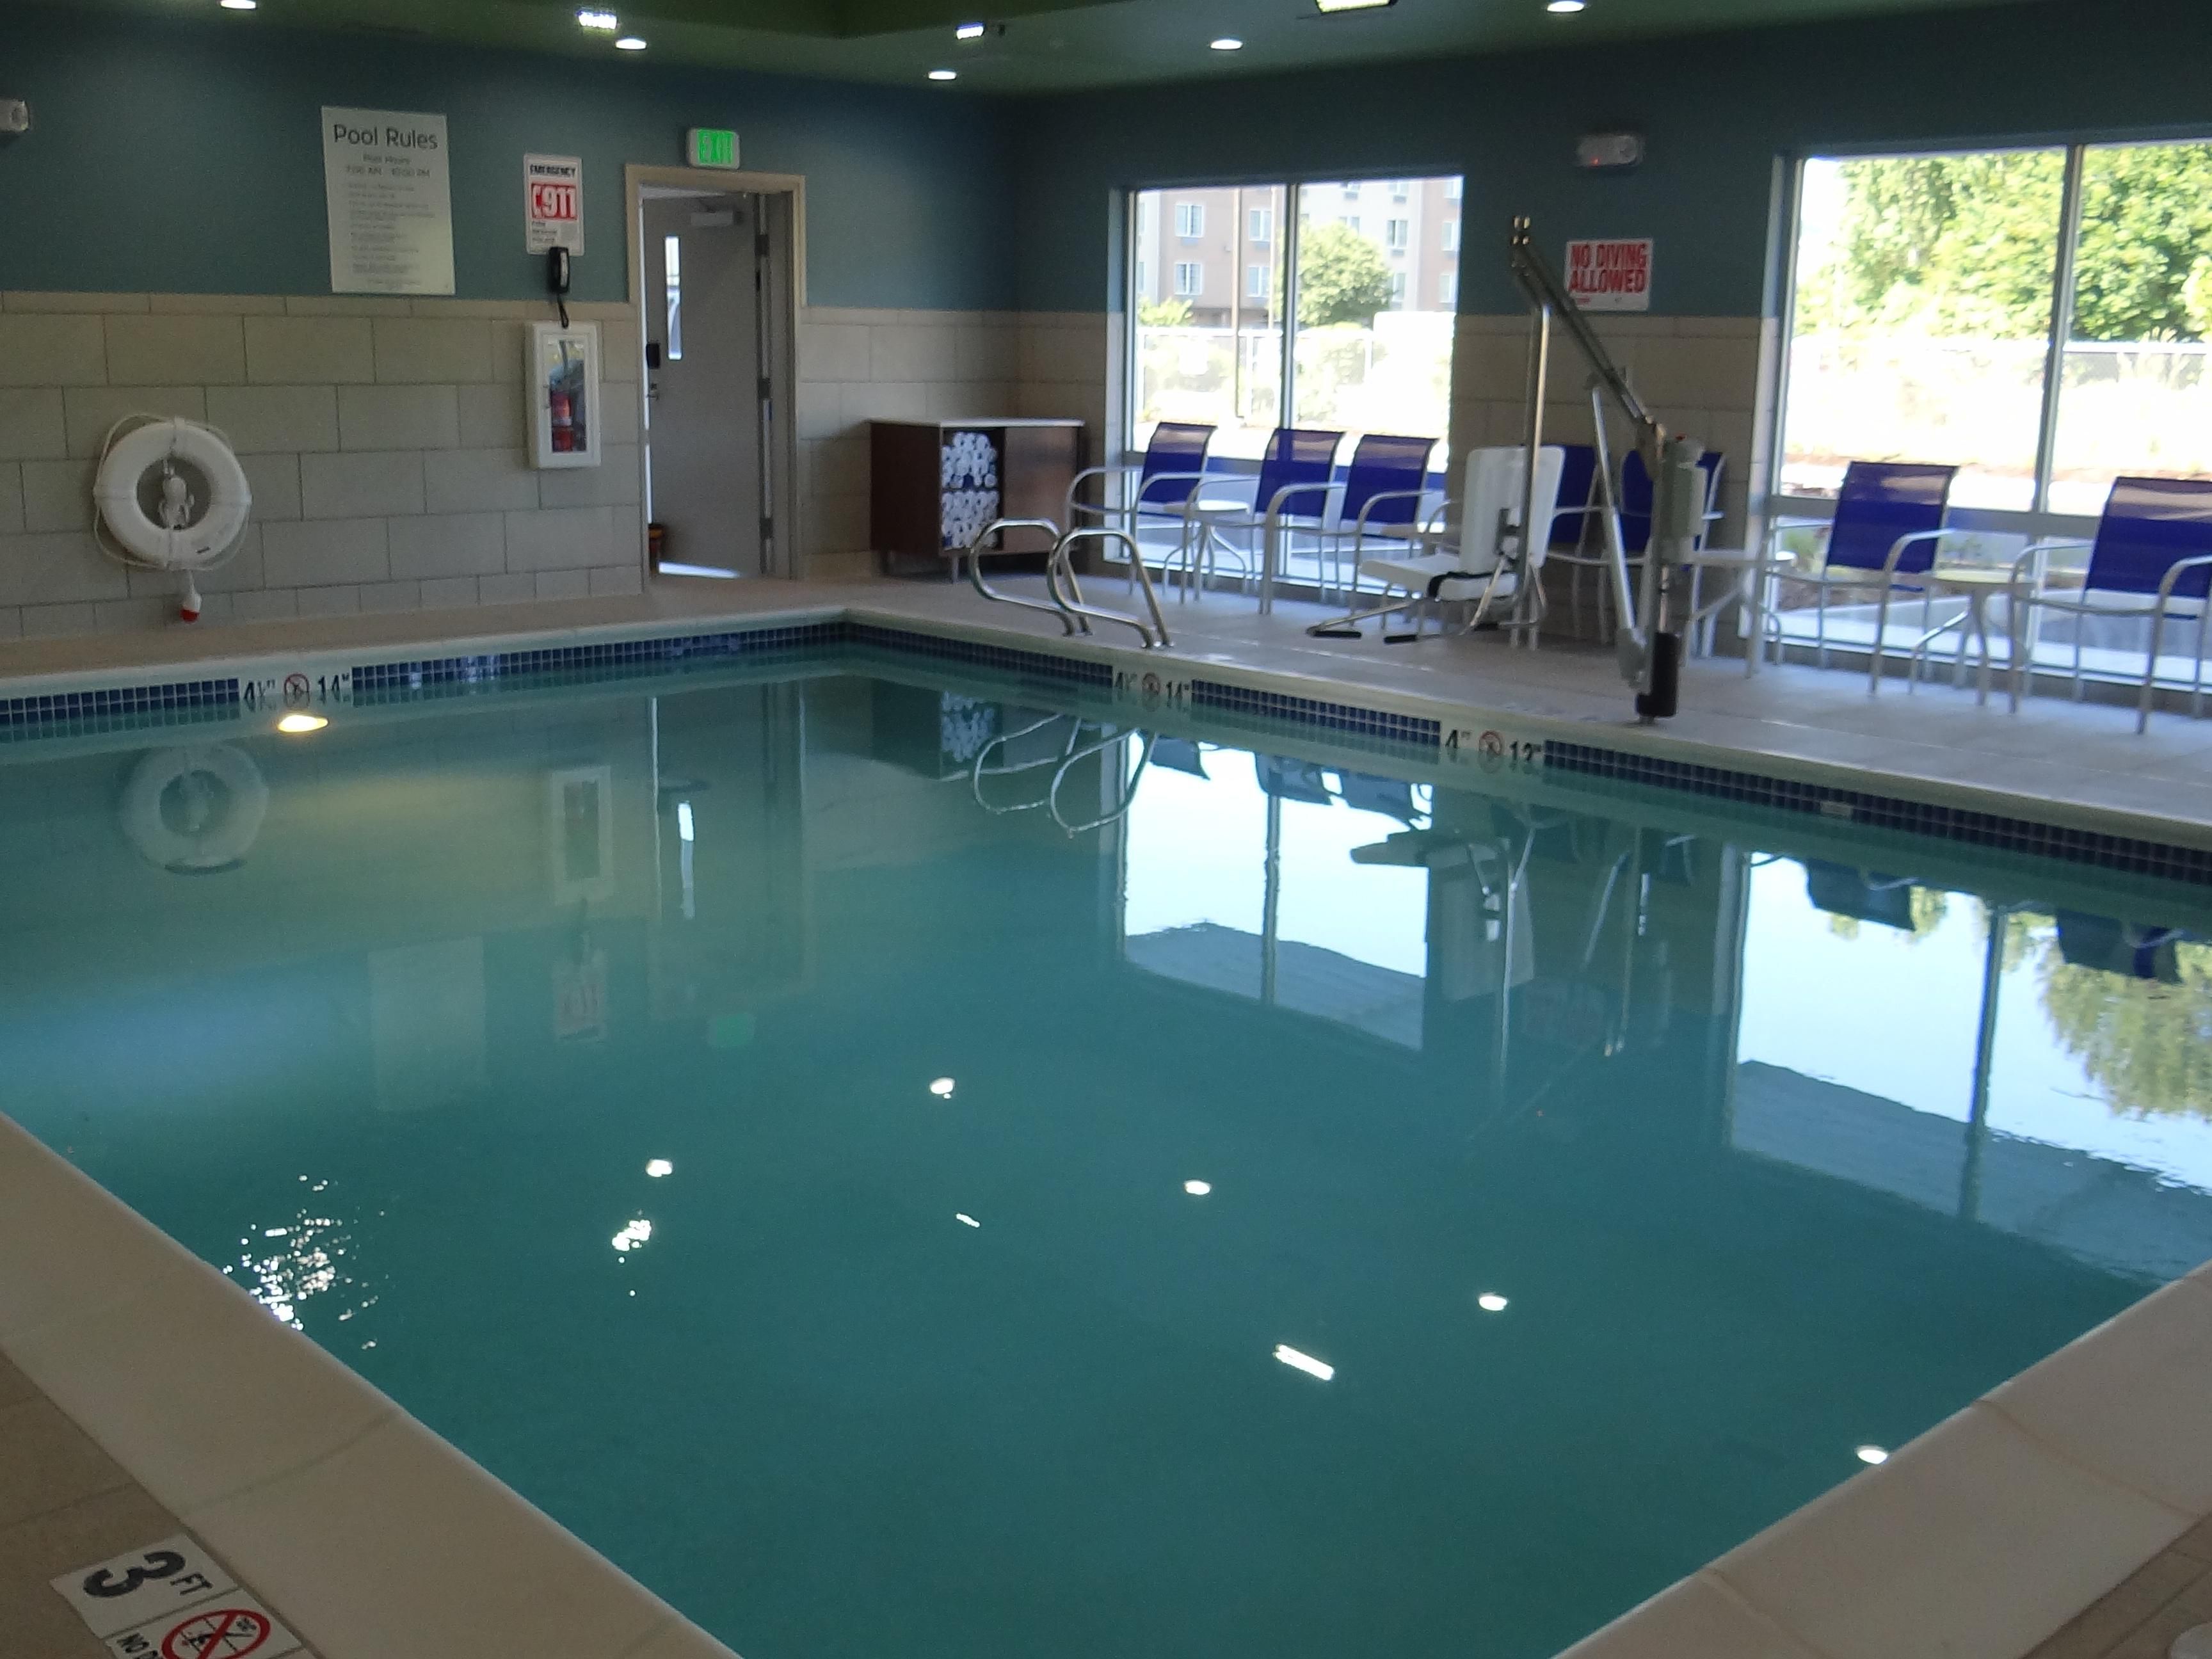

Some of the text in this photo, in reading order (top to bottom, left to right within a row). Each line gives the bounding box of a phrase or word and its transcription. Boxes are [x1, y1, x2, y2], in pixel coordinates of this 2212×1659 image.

[333, 124, 438, 150] Pool Rules
[699, 132, 733, 164] EXIT
[530, 164, 575, 177] EMERGENCY
[541, 186, 577, 219] 911
[1571, 243, 1647, 268] NO DIVING
[1568, 269, 1647, 294] ALLOWED
[83, 1550, 214, 1598] 3 FT
[116, 1633, 150, 1653] NO
